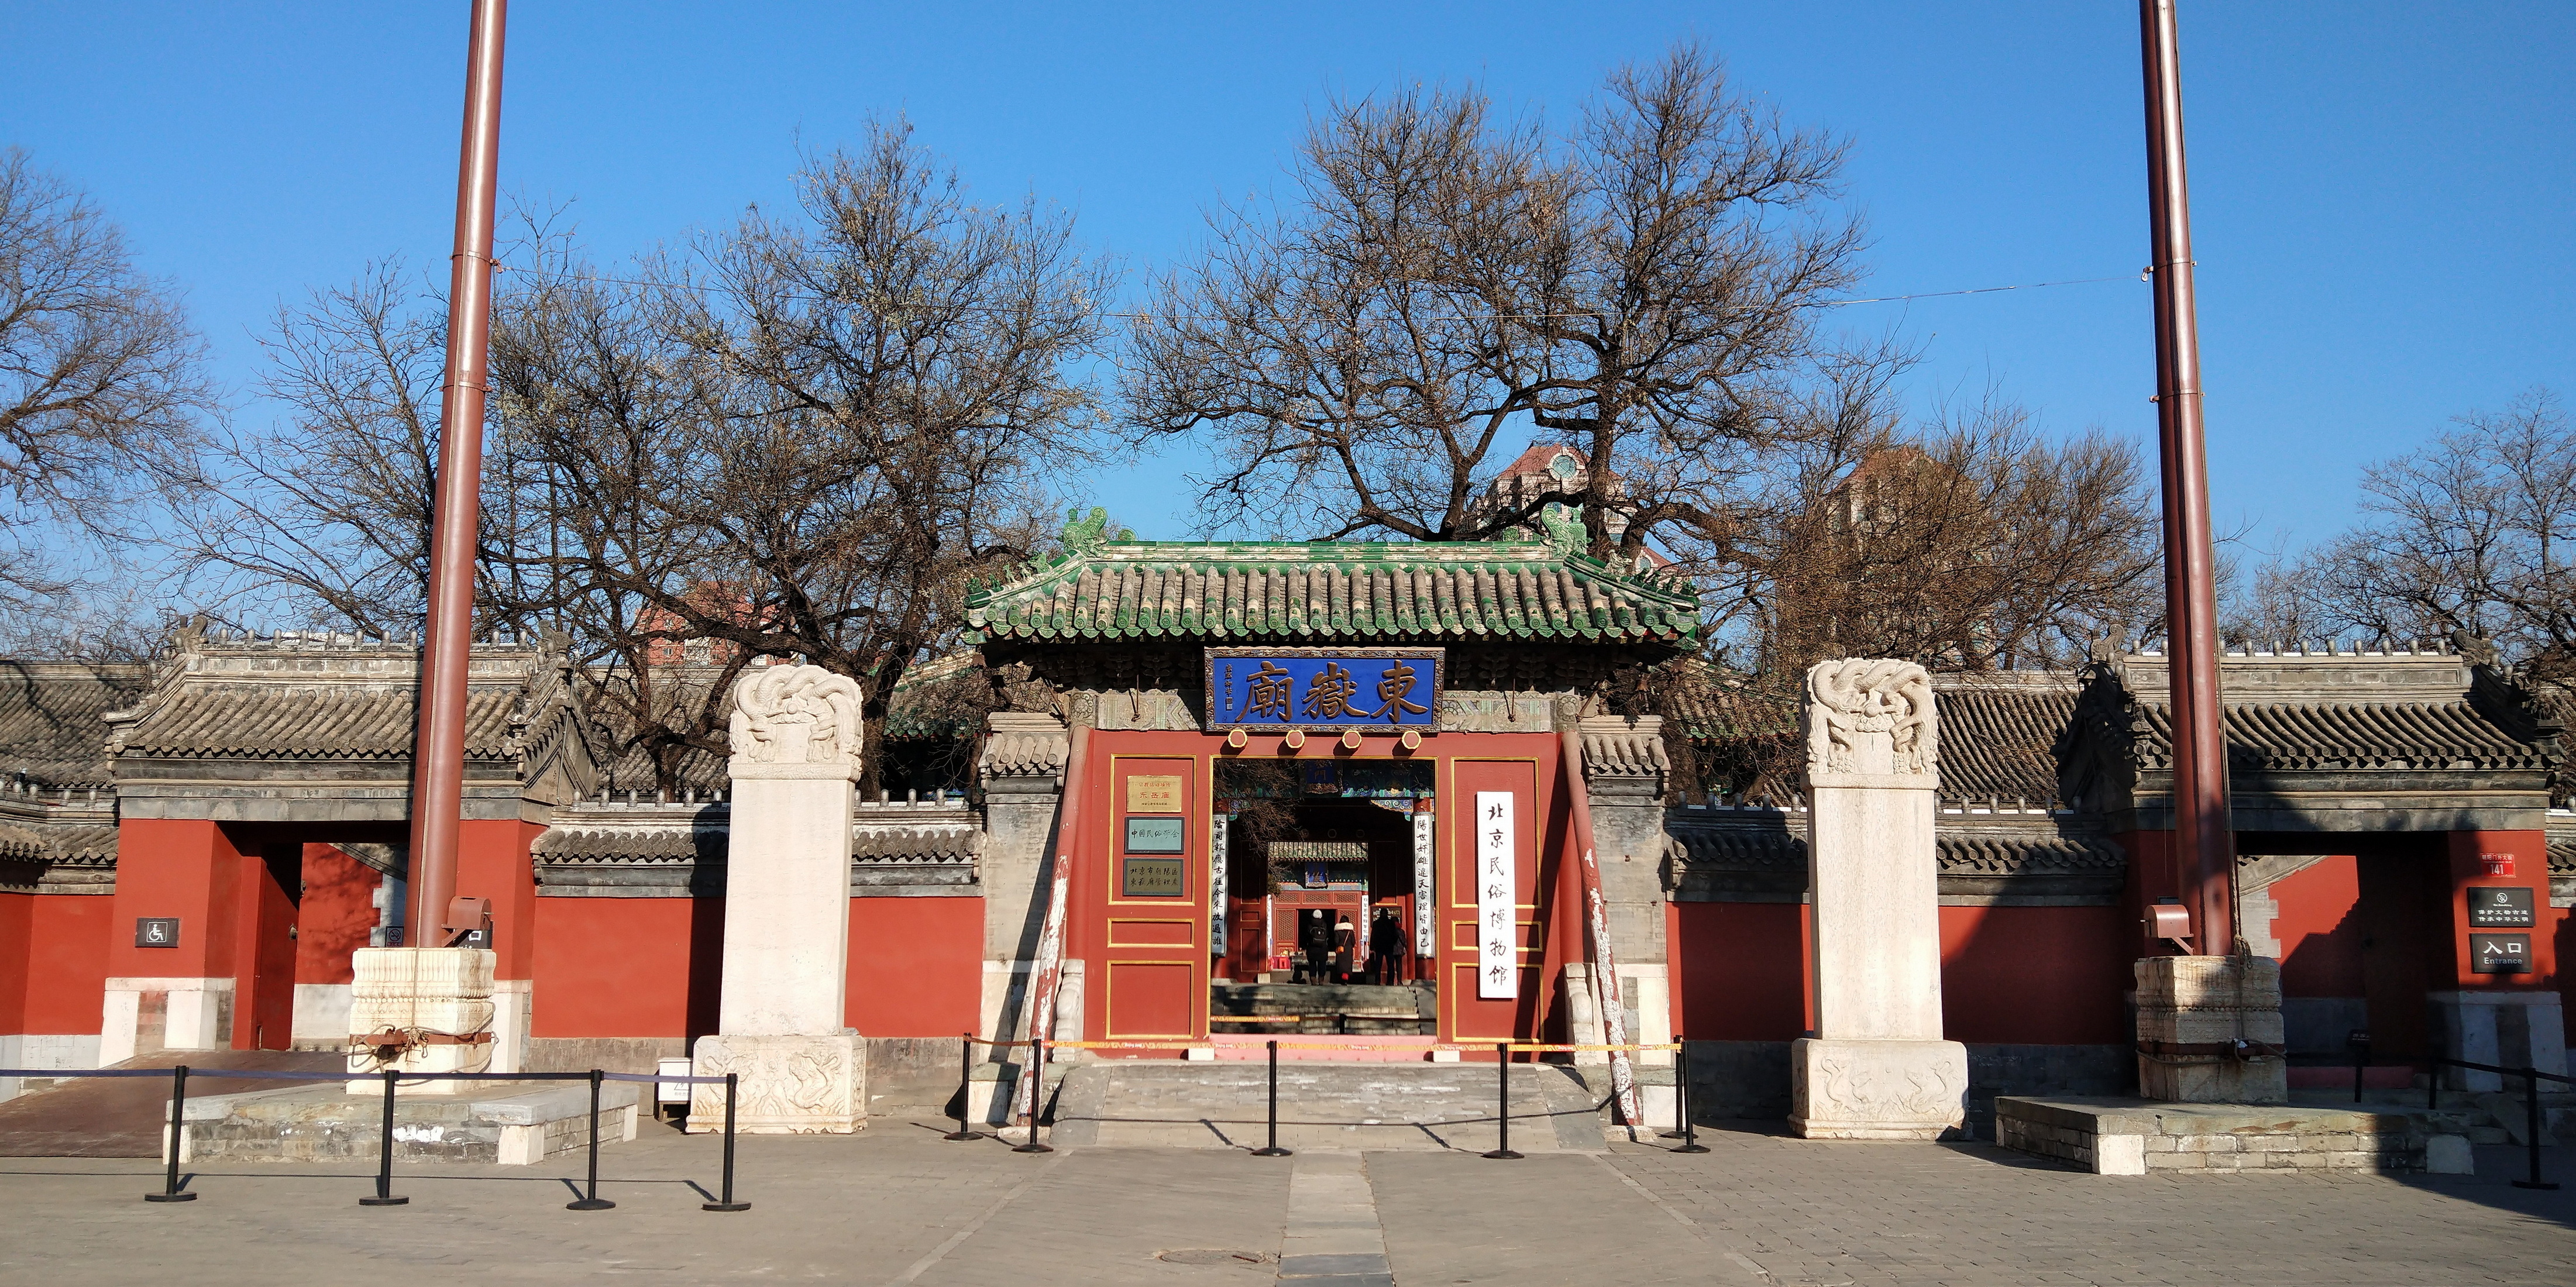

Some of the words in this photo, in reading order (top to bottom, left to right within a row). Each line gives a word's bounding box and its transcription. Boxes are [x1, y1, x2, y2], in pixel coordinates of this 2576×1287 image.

[1131, 829, 1179, 839] 中国民俗学会
[2490, 864, 2503, 875] 141
[1488, 803, 1507, 986] 北京民俗博物馆
[2483, 941, 2522, 954] 入口
